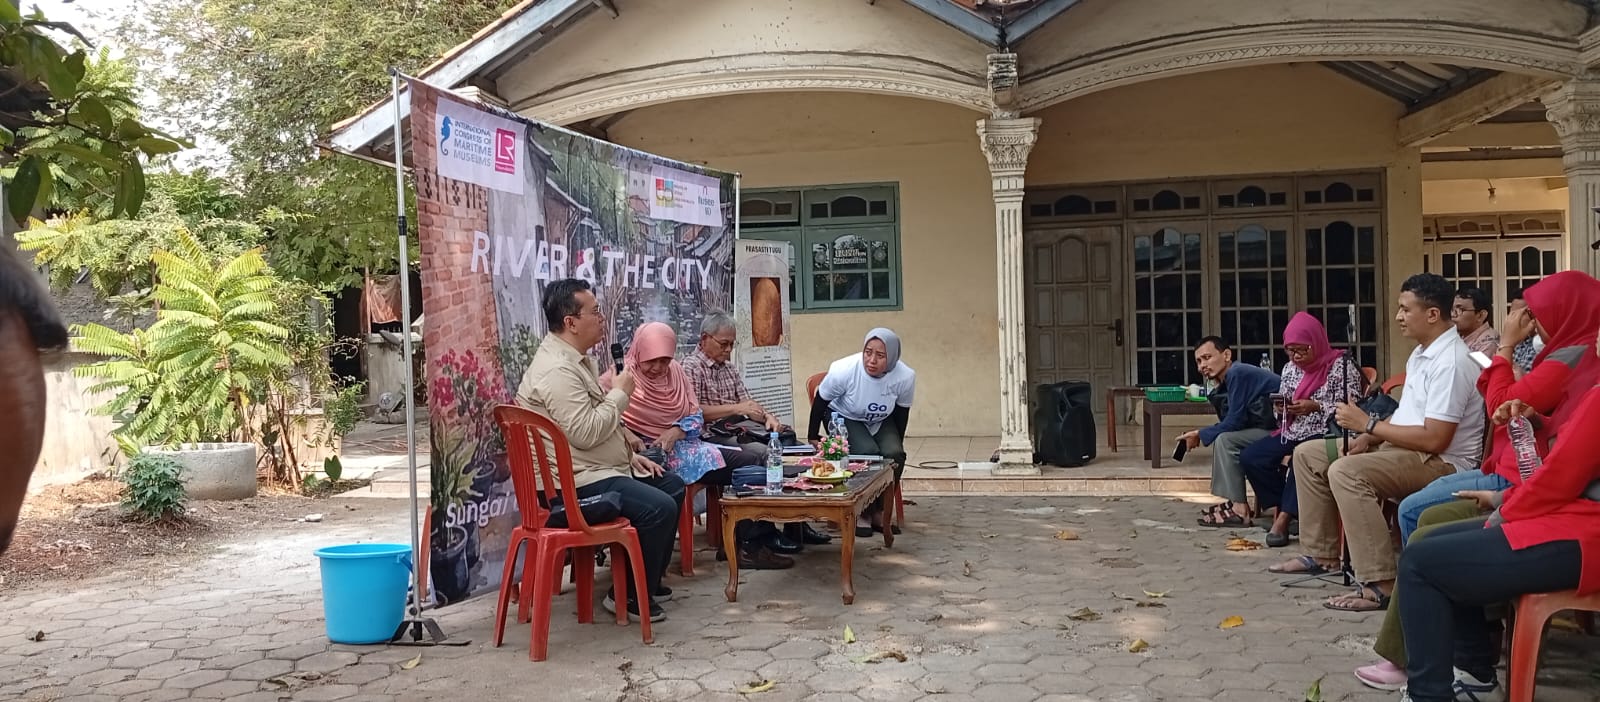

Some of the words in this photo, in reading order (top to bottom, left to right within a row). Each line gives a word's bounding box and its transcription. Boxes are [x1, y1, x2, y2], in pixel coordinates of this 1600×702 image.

[454, 129, 483, 144] CONGRESS
[455, 121, 491, 137] INTERNATIONA
[453, 138, 492, 157] MARITIME
[497, 132, 515, 161] LR
[745, 245, 769, 253] PRASASTI
[769, 246, 782, 254] TUGU
[471, 230, 568, 280] RIVER
[602, 250, 656, 289] THE
[661, 256, 713, 290] CITY
[867, 402, 888, 412] Go
[445, 491, 510, 527] Sungai
